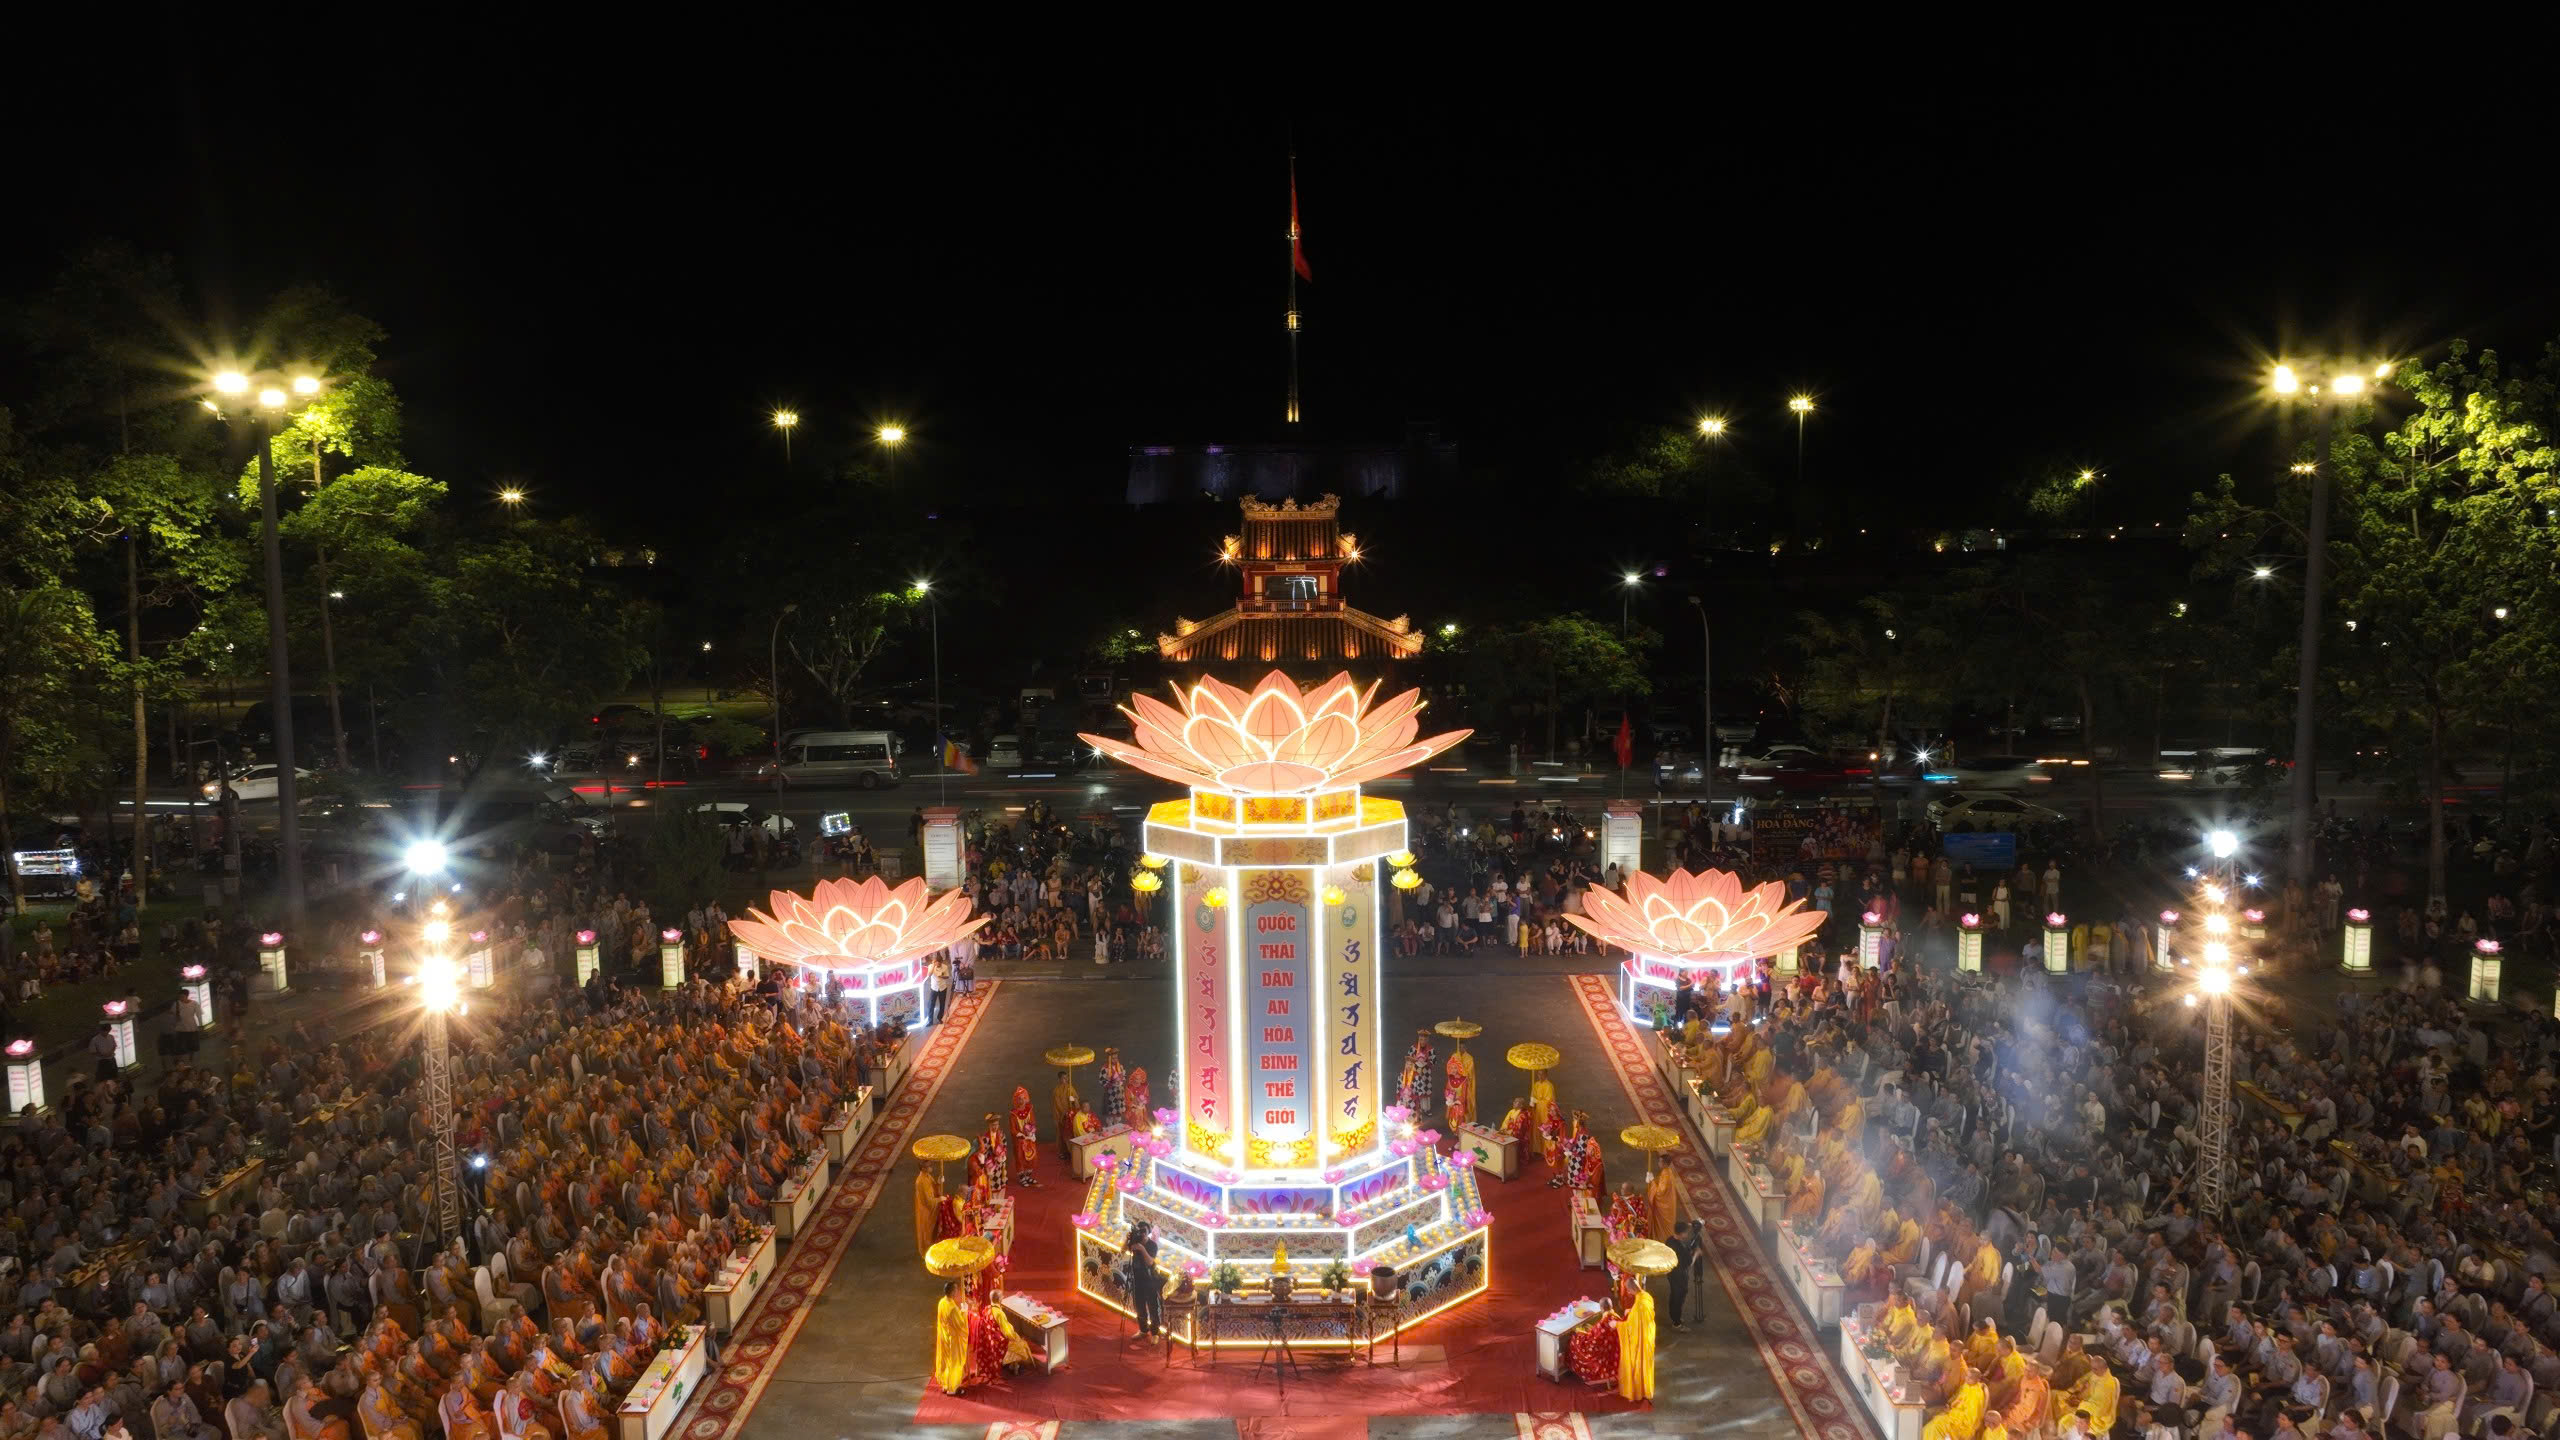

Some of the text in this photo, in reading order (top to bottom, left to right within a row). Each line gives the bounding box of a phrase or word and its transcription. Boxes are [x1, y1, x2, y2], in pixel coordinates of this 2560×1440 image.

[1757, 819, 1780, 829] HOA
[1257, 911, 1297, 934] QUỐC
[1259, 941, 1296, 959] THÁI
[1262, 969, 1294, 987] DÂN
[1267, 999, 1290, 1015] AN
[1263, 1025, 1295, 1042] HÒA
[1260, 1053, 1298, 1071] BÌNH
[1265, 1078, 1295, 1098] THẾ
[1265, 1107, 1296, 1125] GIỚI
